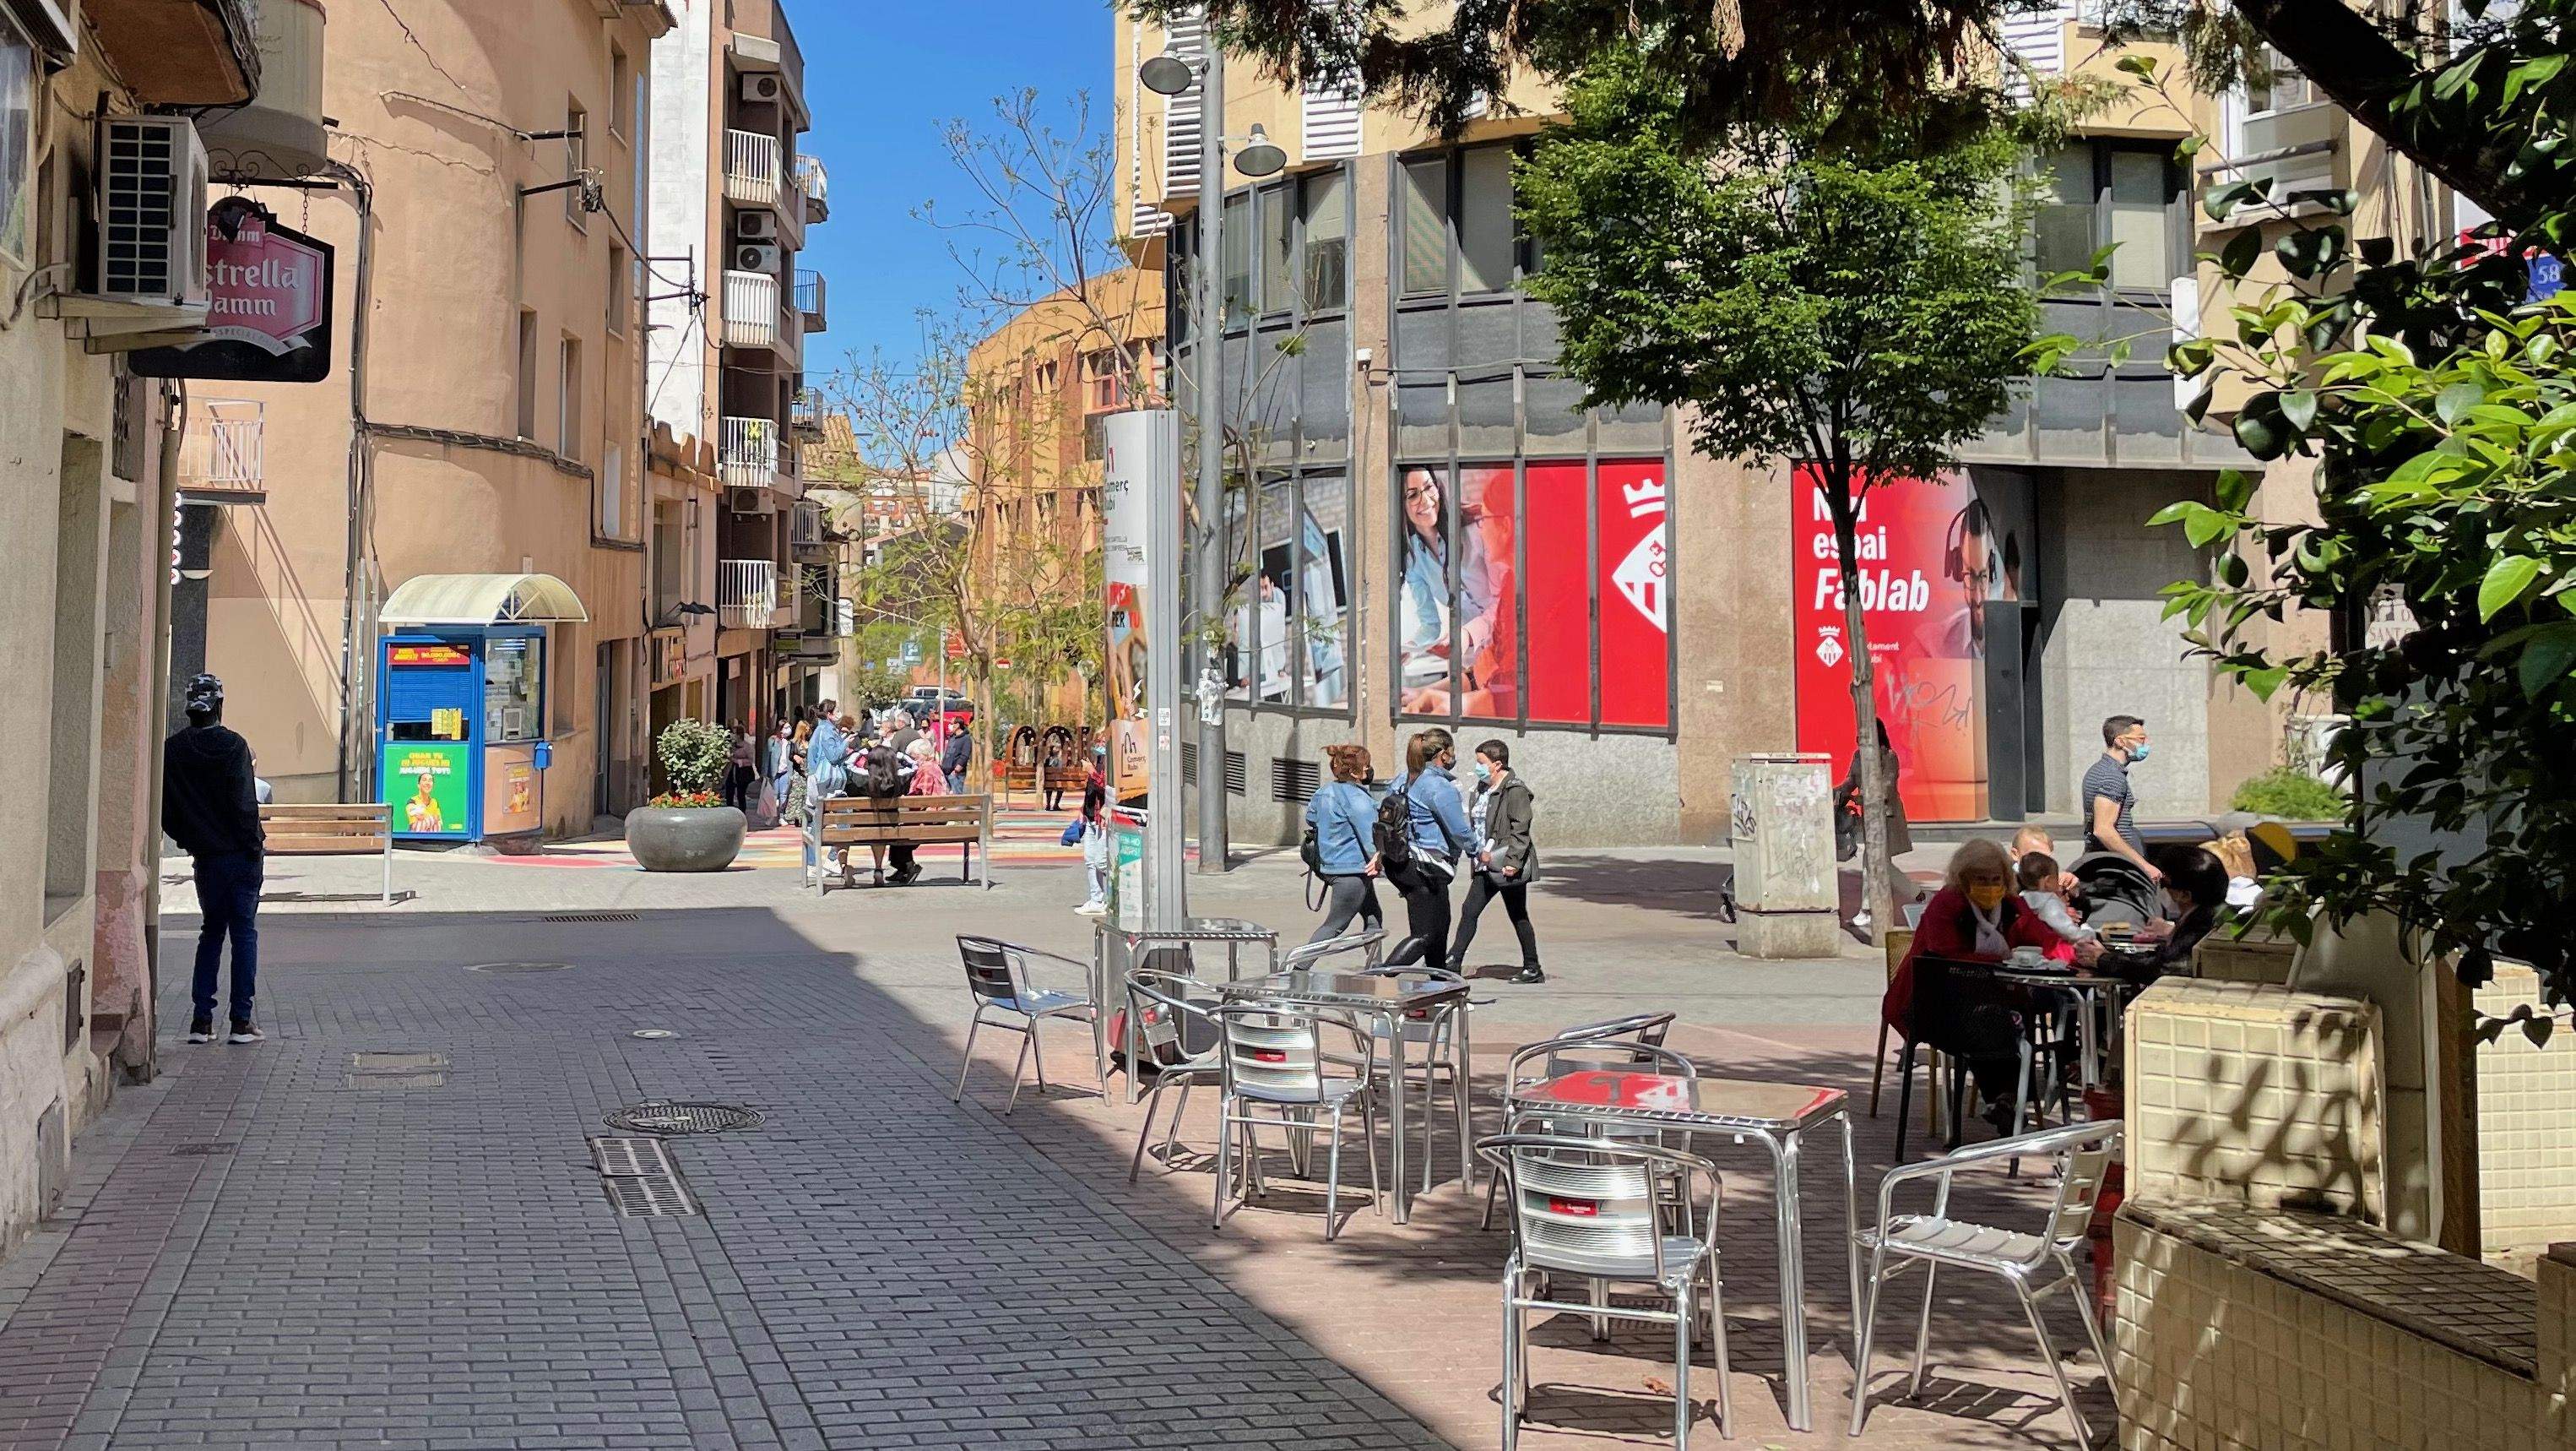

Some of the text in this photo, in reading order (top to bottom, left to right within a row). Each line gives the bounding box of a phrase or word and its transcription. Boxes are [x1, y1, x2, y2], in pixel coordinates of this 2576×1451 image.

[205, 258, 299, 289] strella
[2537, 264, 2561, 285] 58
[207, 288, 277, 316] amm
[1867, 641, 1900, 651] tament
